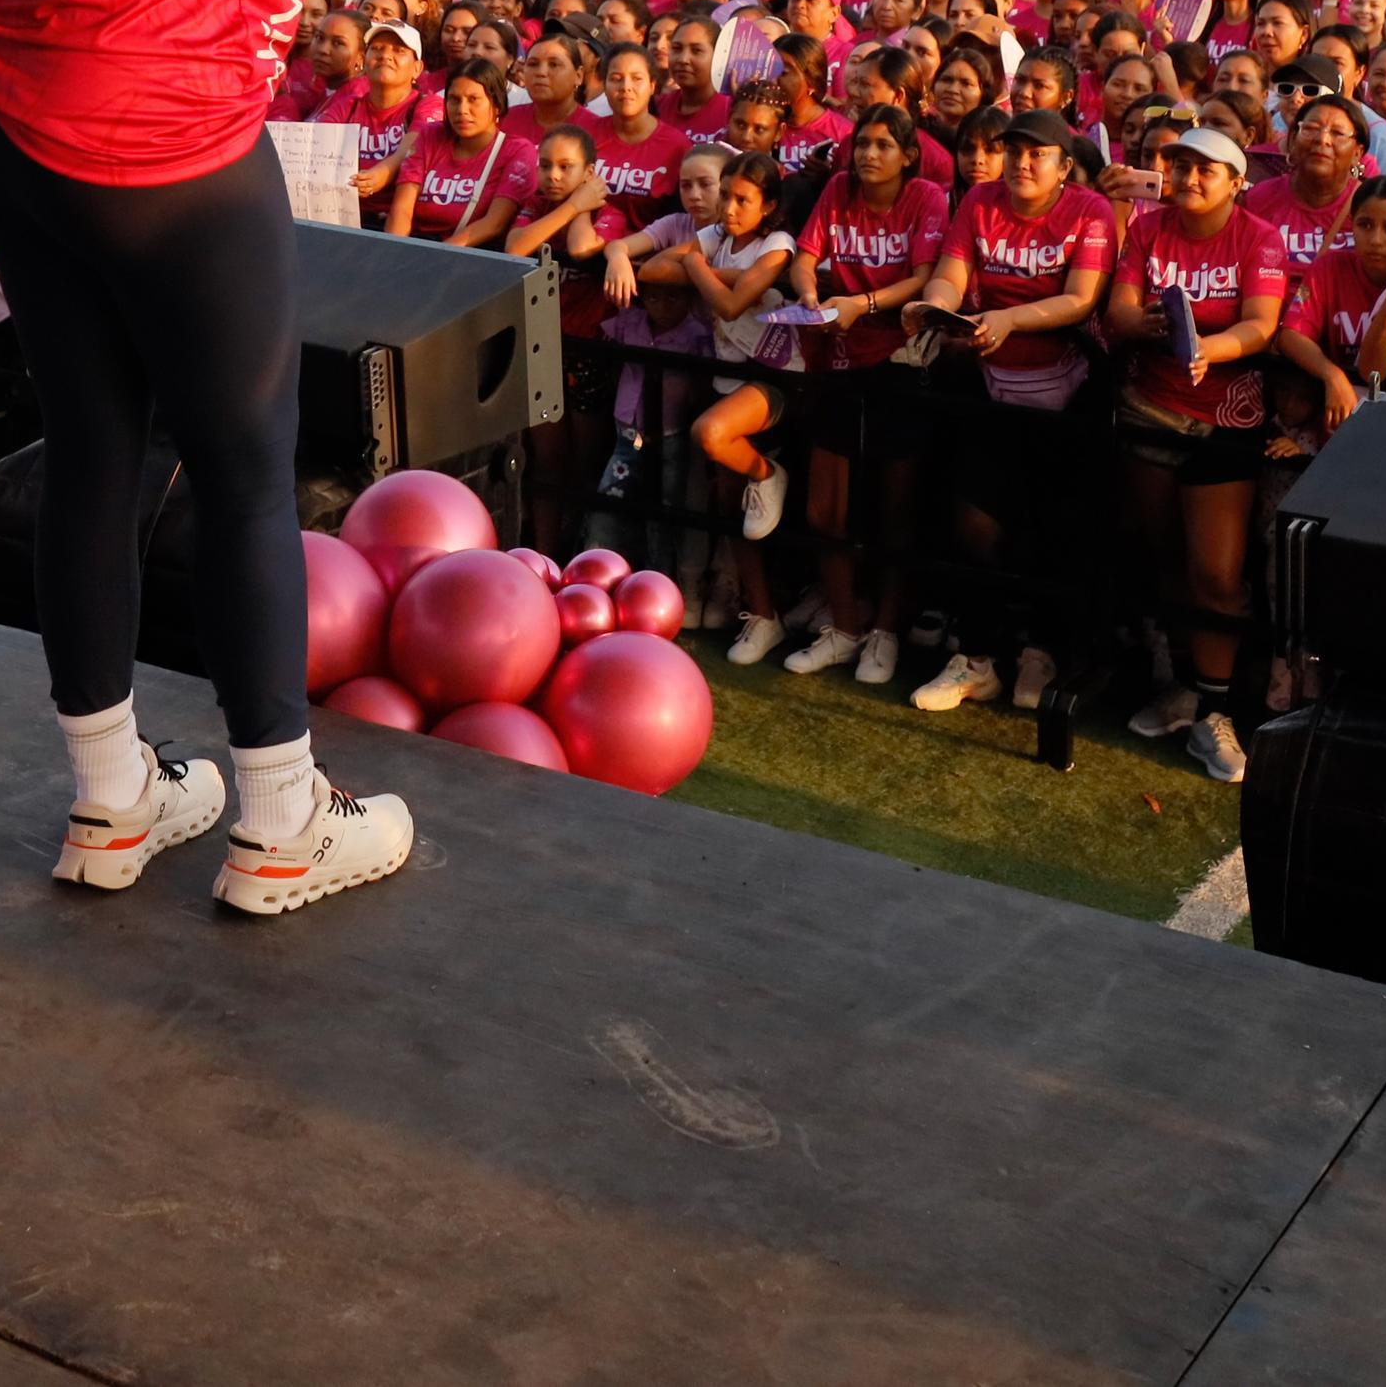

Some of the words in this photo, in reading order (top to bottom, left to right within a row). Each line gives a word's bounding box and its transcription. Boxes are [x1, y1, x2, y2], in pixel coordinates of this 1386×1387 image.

[359, 123, 404, 160] uje
[829, 224, 913, 268] Mujer
[976, 234, 1077, 278] Mujer
[1147, 256, 1239, 302] Mujer
[1209, 290, 1237, 298] Mente
